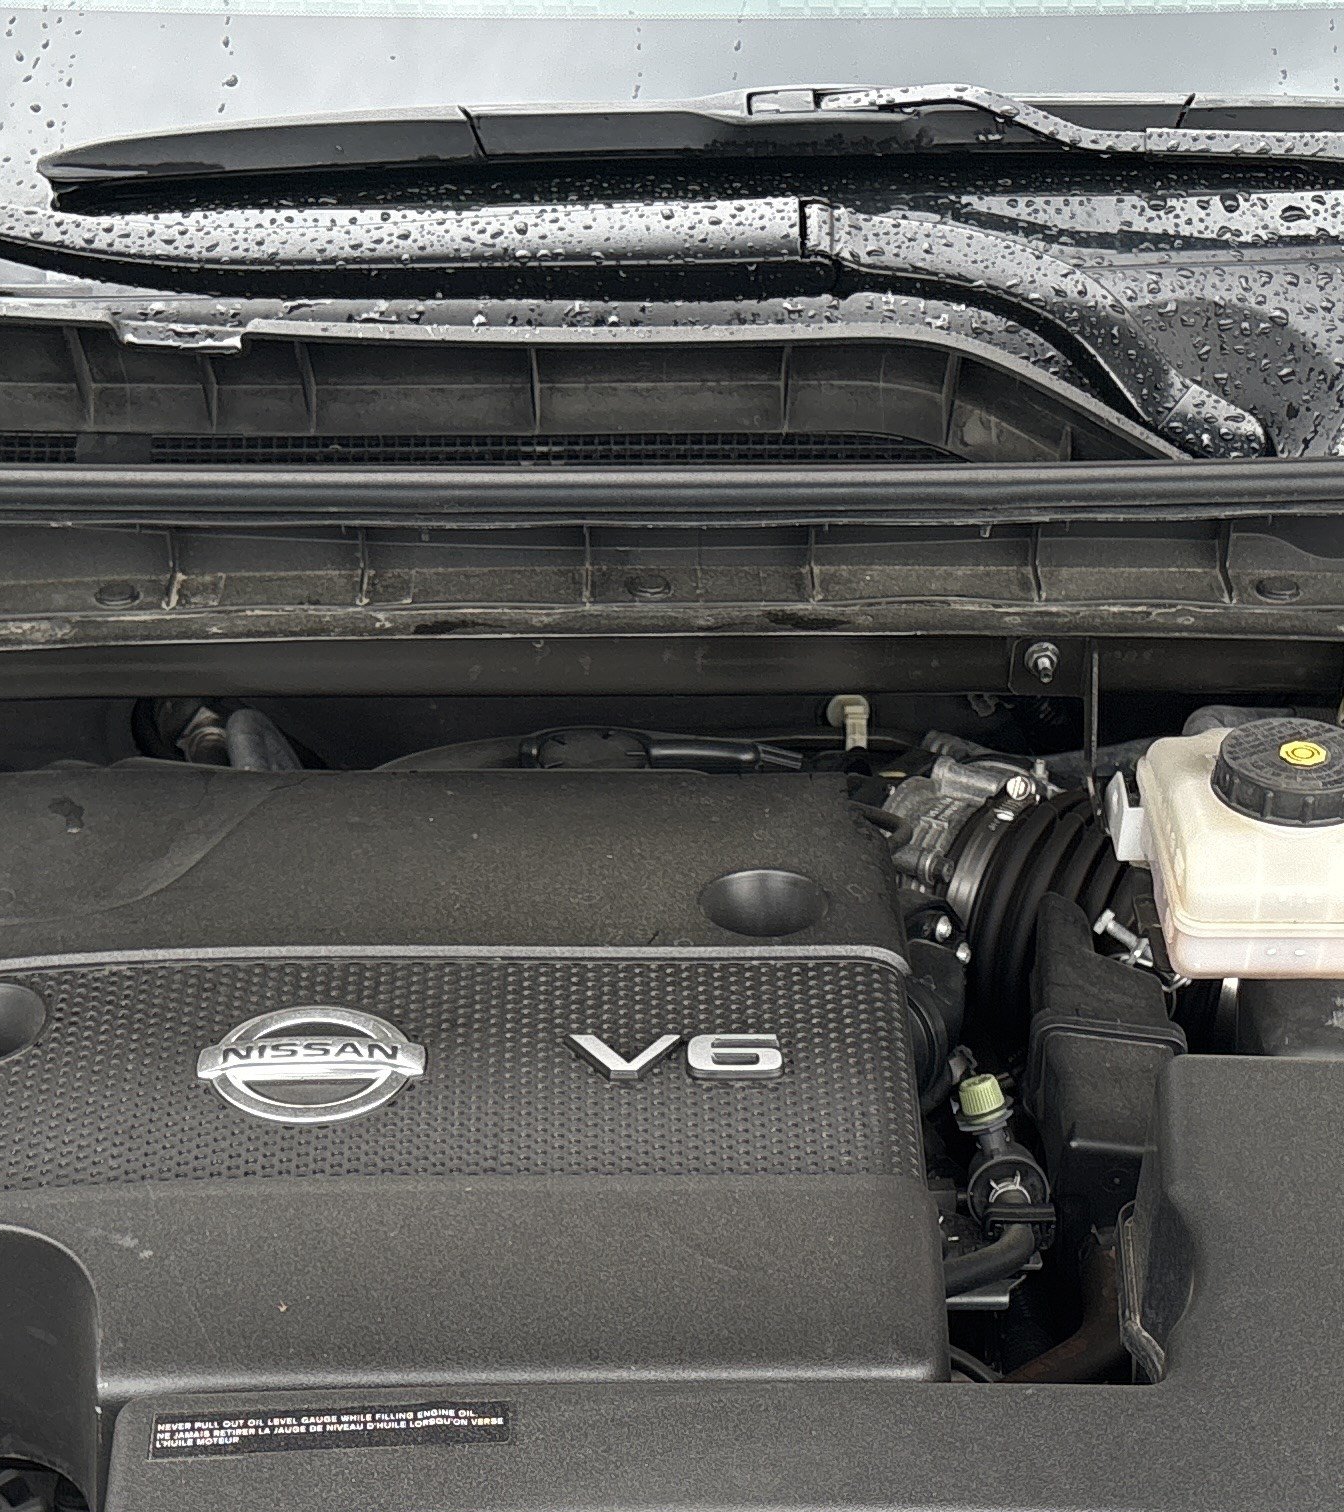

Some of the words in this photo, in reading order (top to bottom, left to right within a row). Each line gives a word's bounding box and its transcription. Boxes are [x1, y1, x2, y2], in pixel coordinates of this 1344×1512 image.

[221, 1041, 399, 1064] NISSAN
[565, 1033, 785, 1081] V6
[156, 1432, 171, 1440] NE
[172, 1430, 211, 1439] JAMAIS
[213, 1427, 256, 1437] RETIRER
[258, 1426, 271, 1434] LA
[272, 1424, 307, 1434] JAUGE
[309, 1424, 324, 1432] DE
[326, 1421, 364, 1431] NIVEAU
[470, 1416, 505, 1426] VERSE
[157, 1422, 192, 1431] NEVER
[194, 1421, 220, 1429] PULL
[222, 1419, 245, 1428] OUT
[247, 1418, 266, 1427] OIL
[267, 1417, 299, 1426] LEVEL
[300, 1415, 338, 1424] GAUGE
[340, 1413, 373, 1422] WHILE
[375, 1411, 414, 1420] FILLING
[416, 1408, 456, 1418] ENGINE
[196, 1436, 240, 1446] MOTEUR
